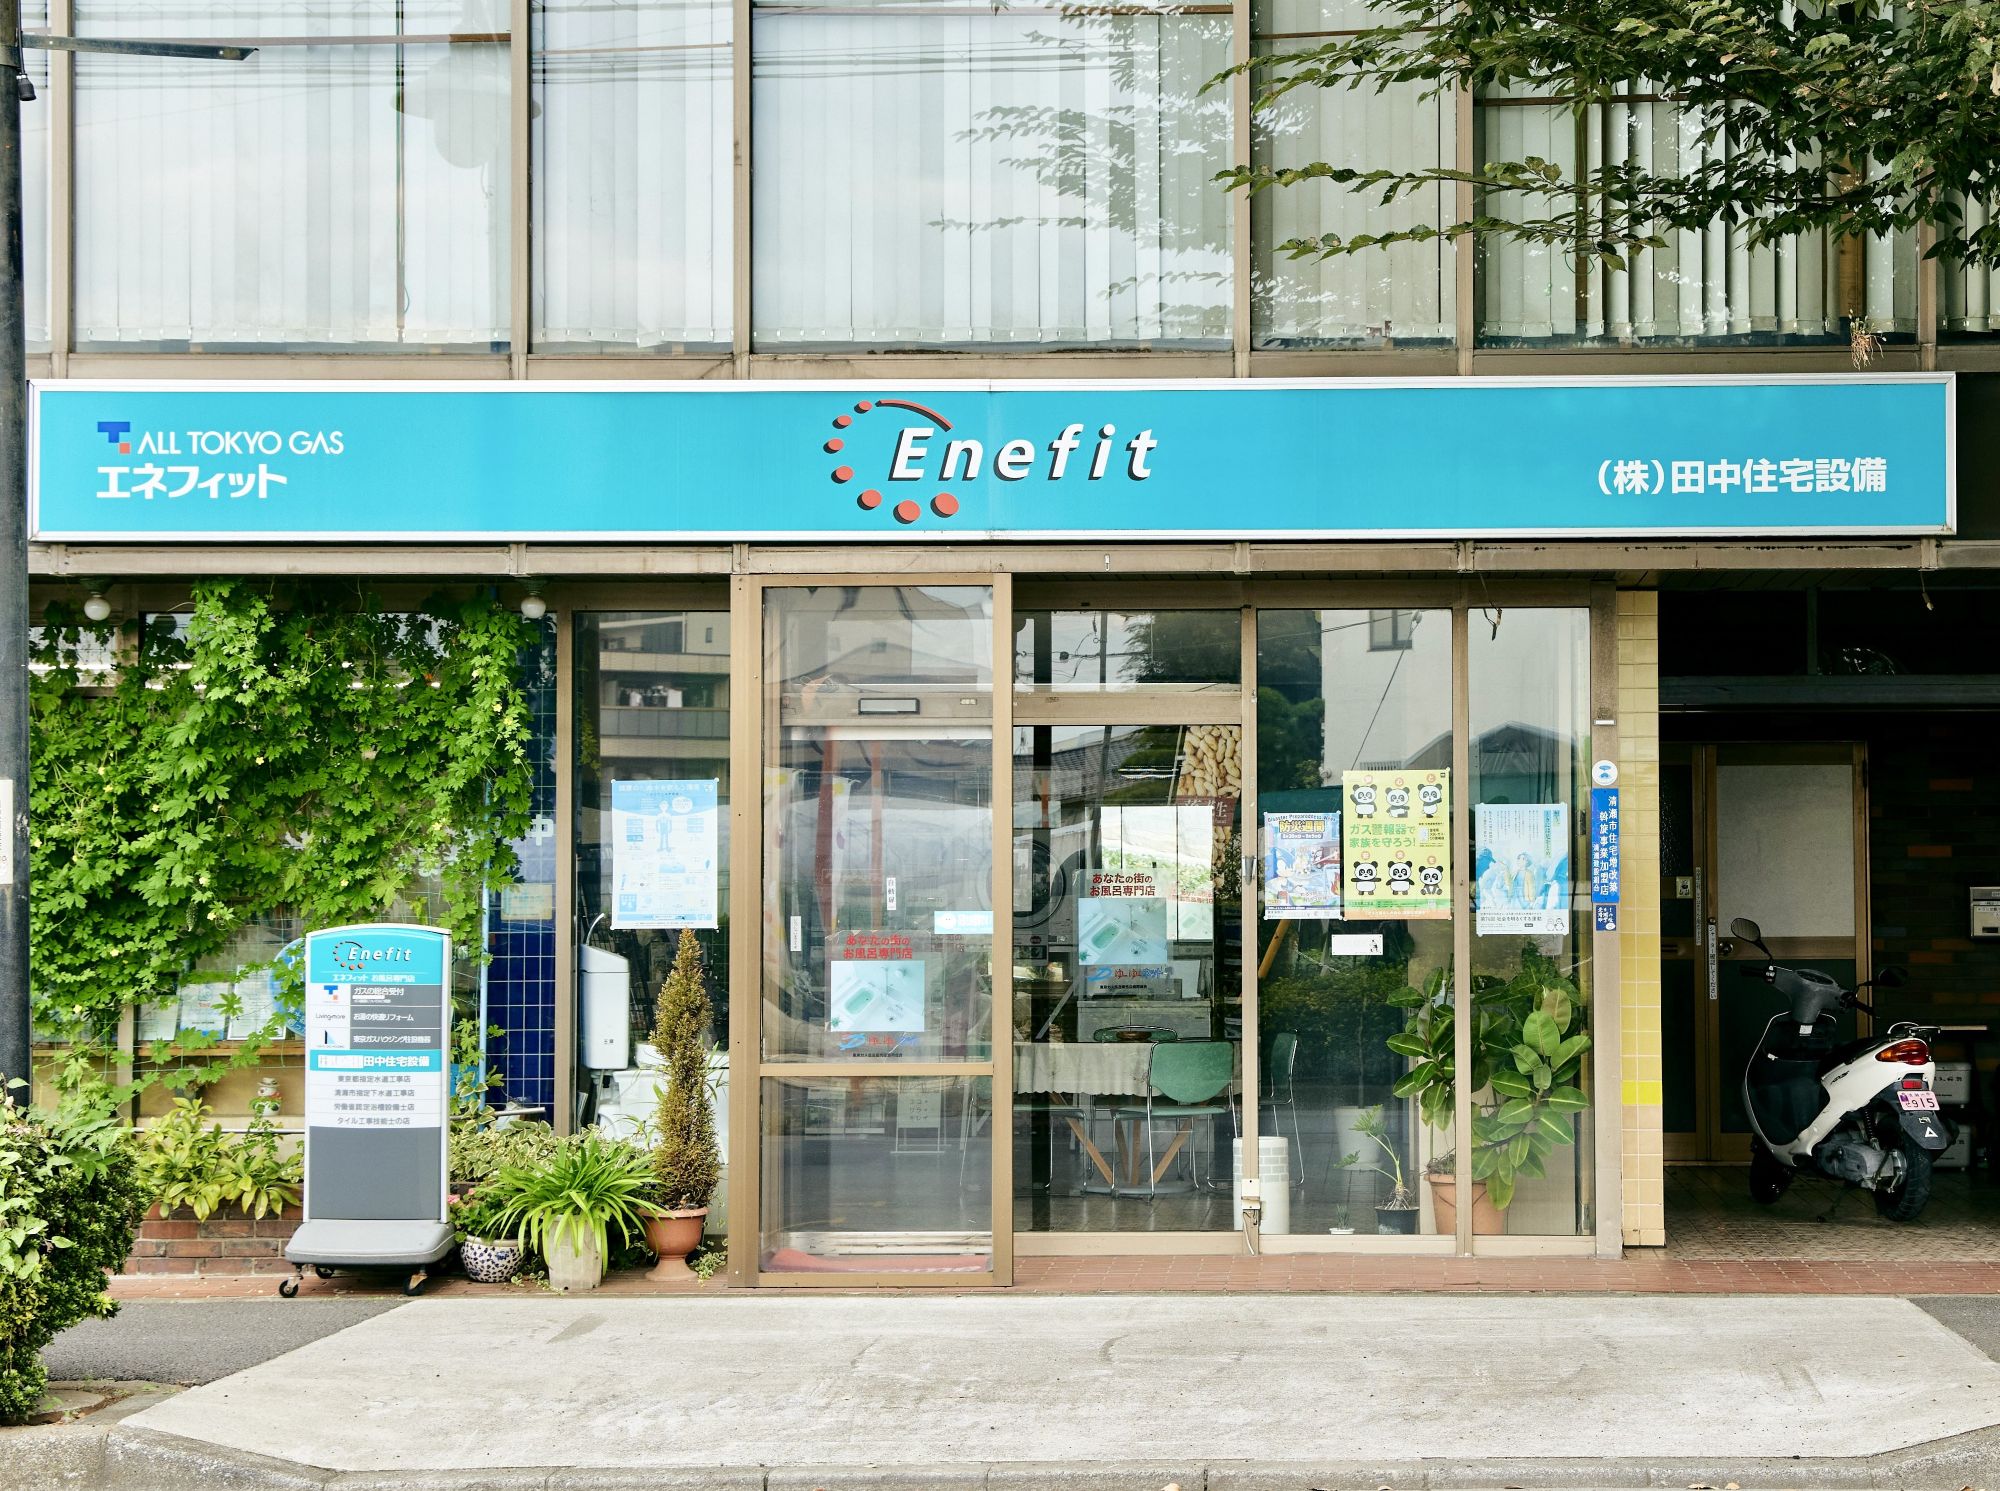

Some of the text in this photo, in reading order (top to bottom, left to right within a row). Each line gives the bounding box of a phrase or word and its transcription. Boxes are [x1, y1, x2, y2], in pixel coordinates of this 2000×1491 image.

[137, 430, 344, 455] ALL TOKYO GAS
[888, 423, 1158, 482] Enefit
[96, 463, 288, 500] エネフィット
[1597, 456, 1888, 496] (株)田中住宅設備
[1349, 823, 1415, 835] ガス警報器で
[1092, 873, 1153, 883] あなたの街の
[1089, 885, 1156, 897] お風呂専門店
[846, 934, 910, 945] あなたの街の
[348, 946, 413, 962] Enefit
[843, 947, 913, 959] お風呂専門店
[363, 1055, 430, 1067] 田中住宅設備
